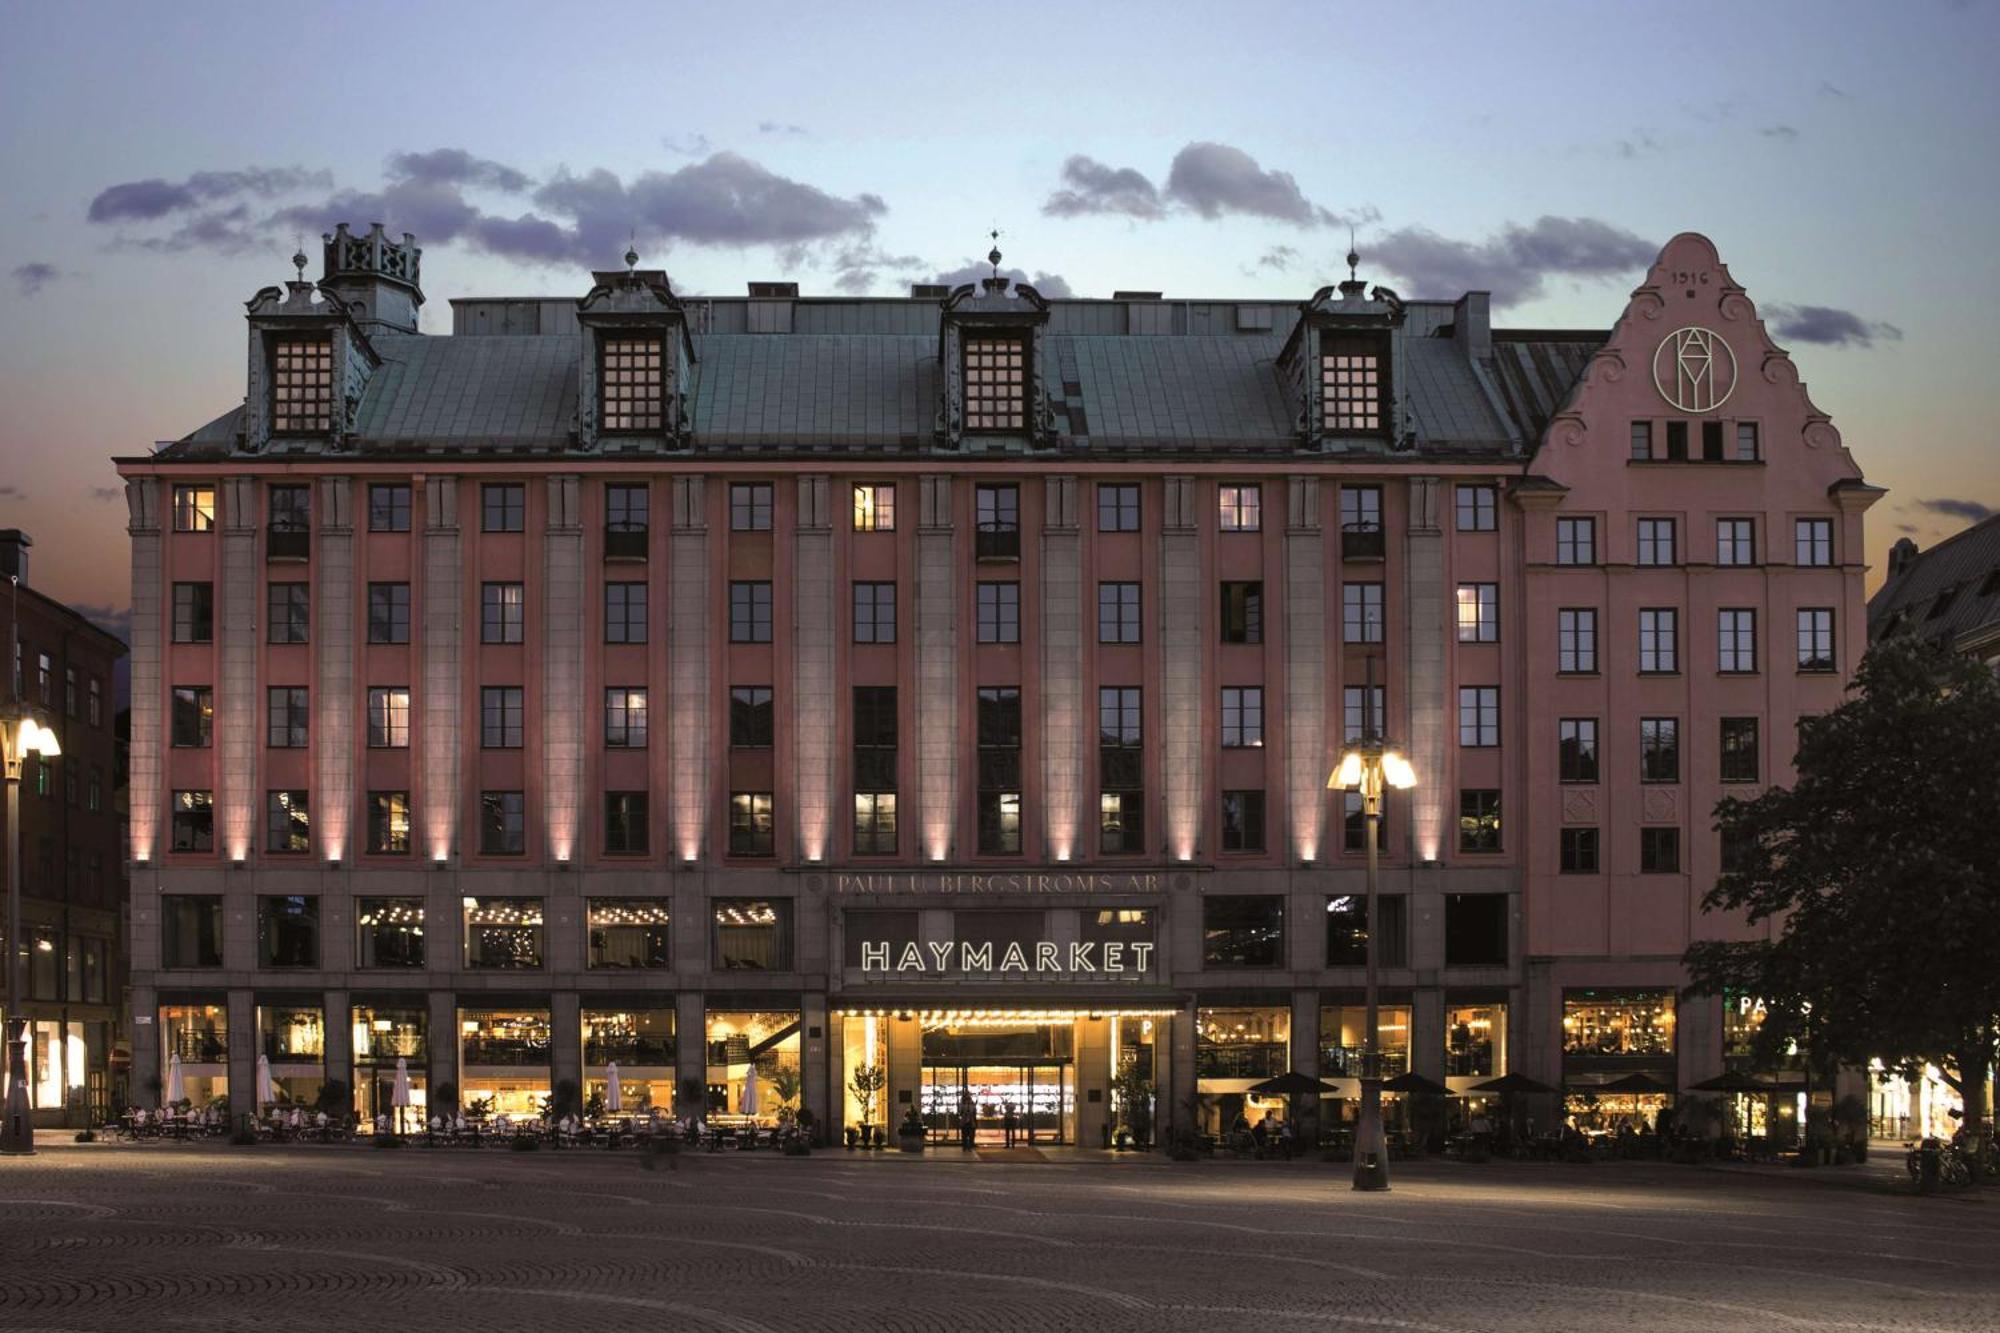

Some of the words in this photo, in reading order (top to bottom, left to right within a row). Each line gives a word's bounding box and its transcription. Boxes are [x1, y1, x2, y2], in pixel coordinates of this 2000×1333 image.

[1671, 271, 1709, 285] 1916
[838, 874, 895, 893] PAUL
[1128, 874, 1158, 893] AB
[861, 941, 1154, 972] HAYMARKET
